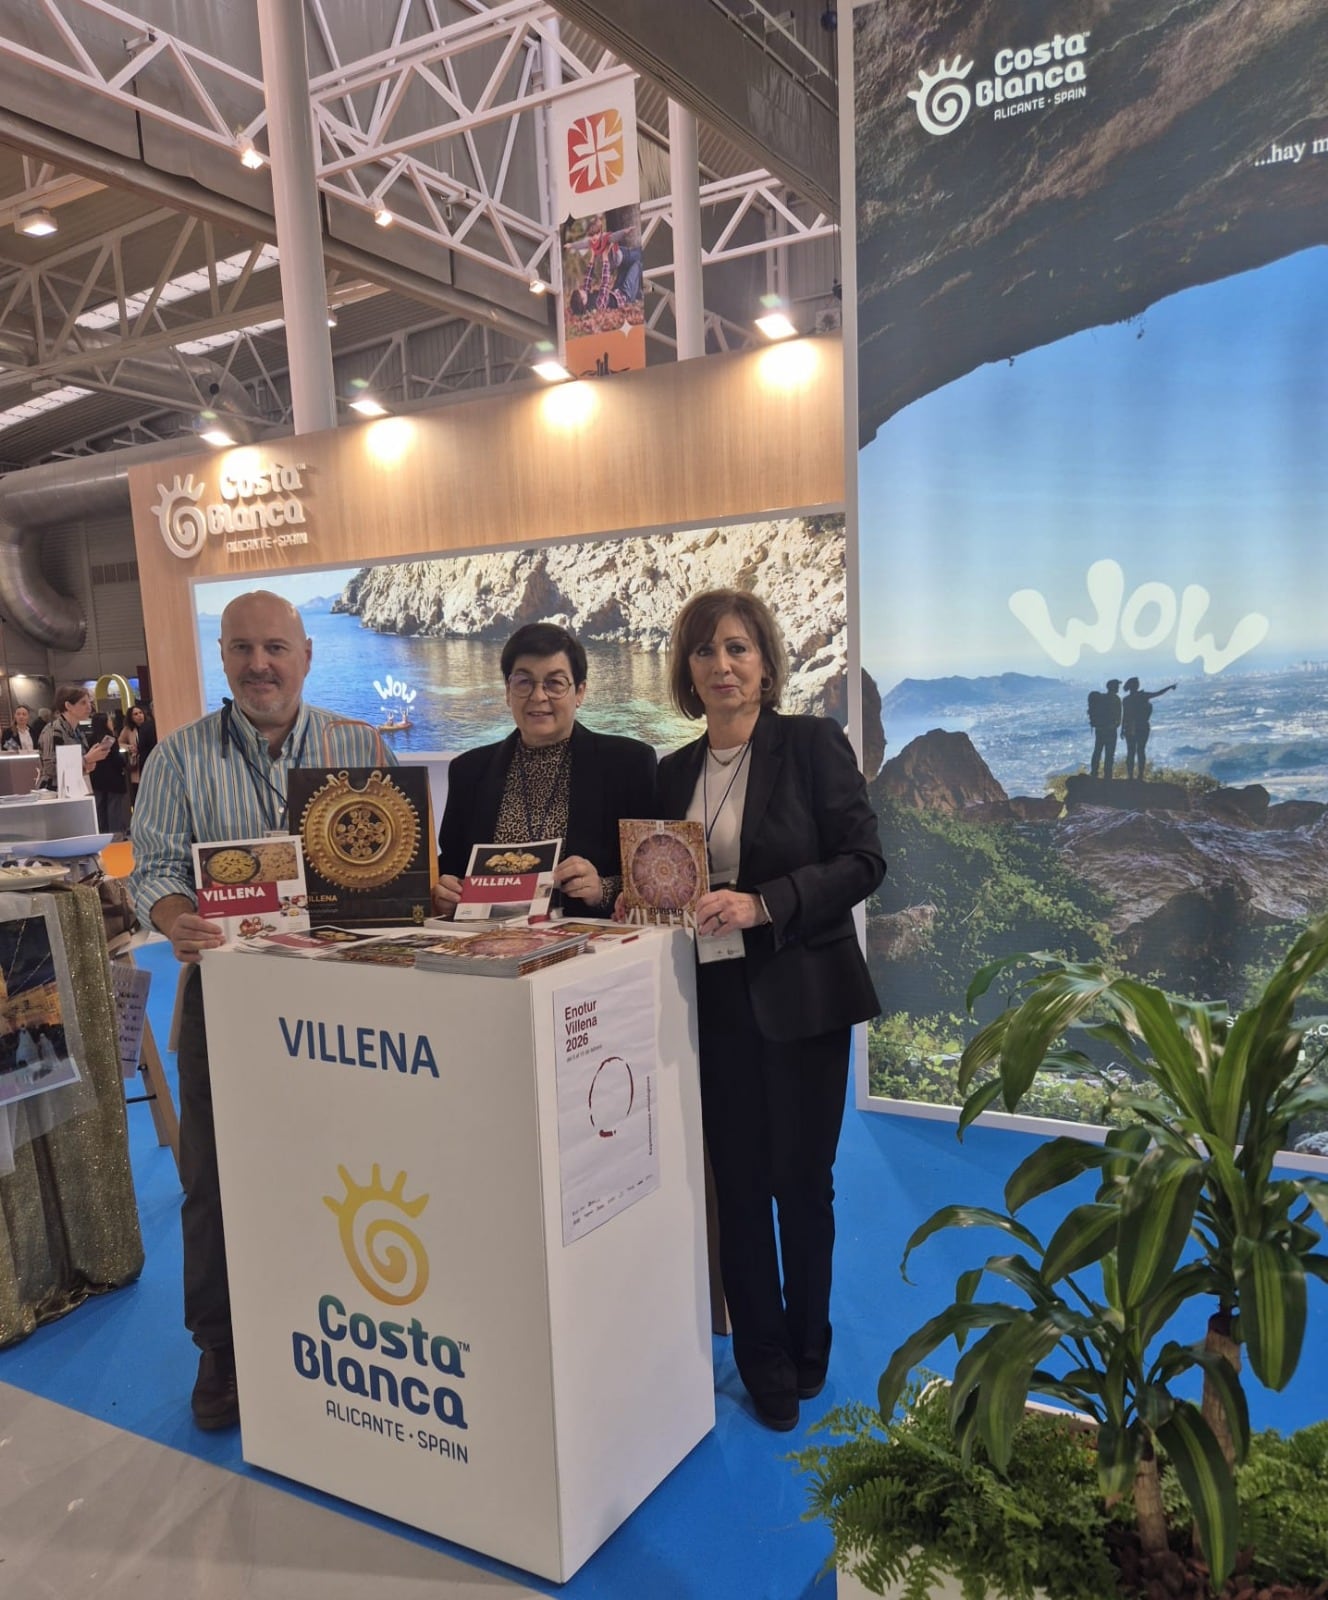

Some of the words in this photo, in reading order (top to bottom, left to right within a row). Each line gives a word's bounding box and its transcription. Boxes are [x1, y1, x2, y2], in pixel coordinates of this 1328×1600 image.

[994, 34, 1087, 76] Costa
[975, 61, 1087, 107] Blanca
[994, 97, 1045, 121] ALICANTE
[1054, 86, 1087, 105] SPAIN
[220, 463, 303, 500] Costa
[206, 498, 306, 535] Blanca
[203, 887, 265, 902] VILLENA
[470, 877, 521, 887] VILLENA
[565, 1000, 597, 1021] Enotur
[565, 1016, 598, 1036] Villena
[278, 1017, 440, 1078] VILLENA
[566, 1032, 589, 1053] 2026
[318, 1294, 466, 1378] Costa
[292, 1331, 468, 1430] Blanca
[326, 1400, 405, 1442] ALICANTE
[417, 1430, 468, 1464] SPAIN
